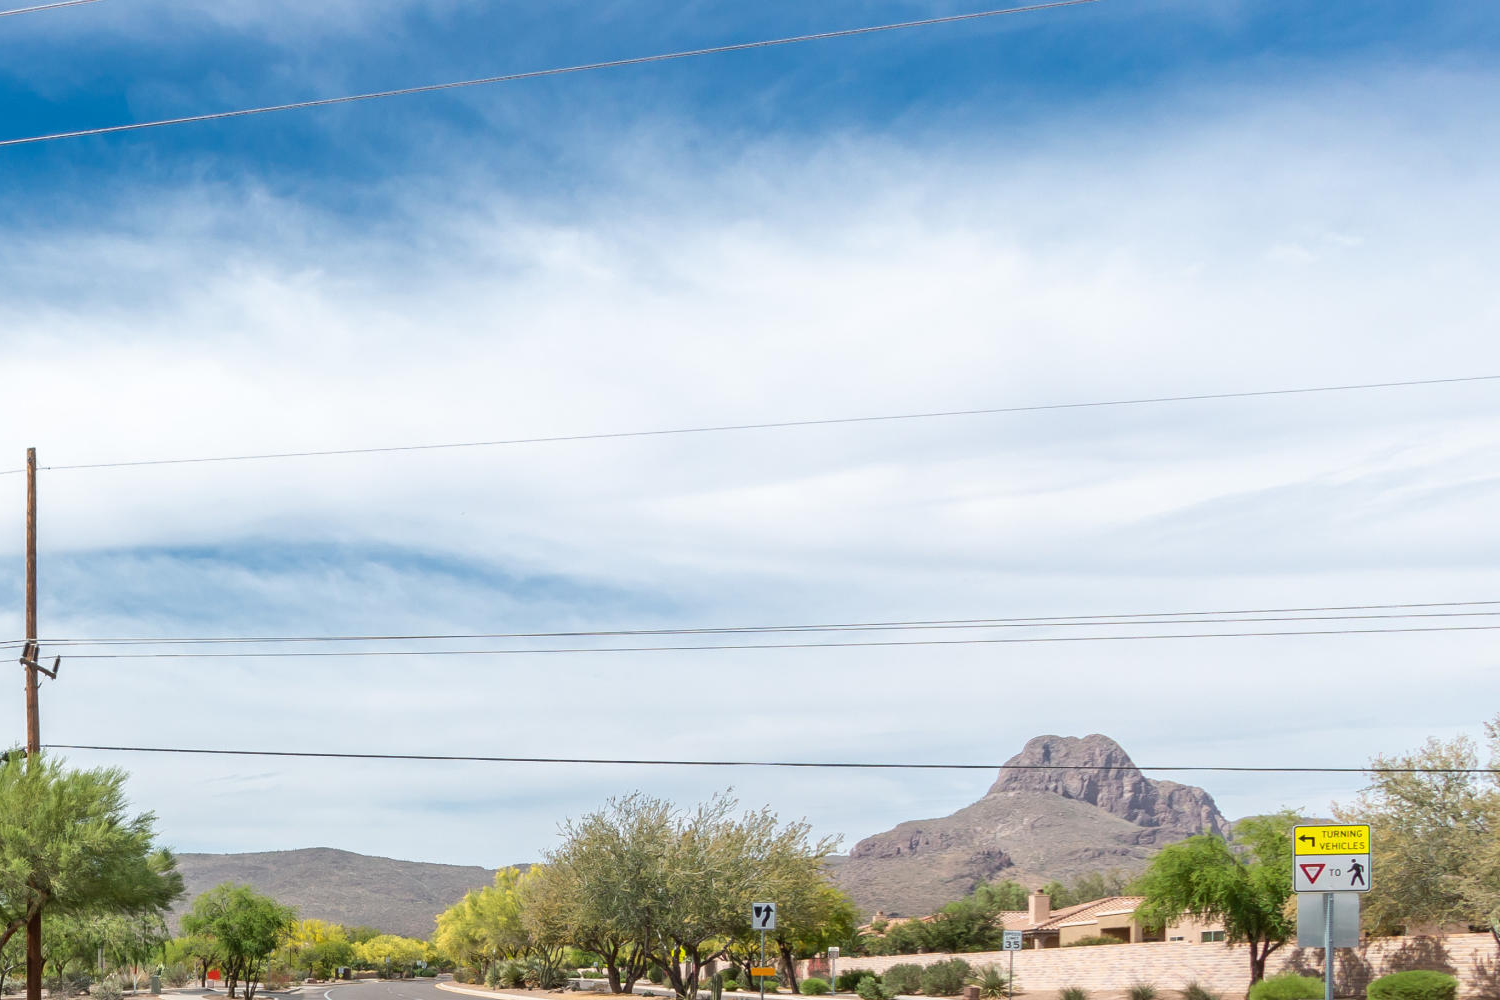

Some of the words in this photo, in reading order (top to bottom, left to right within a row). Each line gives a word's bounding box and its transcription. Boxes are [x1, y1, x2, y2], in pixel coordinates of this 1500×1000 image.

[1321, 830, 1363, 838] TURNING
[1319, 841, 1365, 850] VEHICLES
[1329, 868, 1341, 876] TO
[1005, 941, 1020, 949] 35
